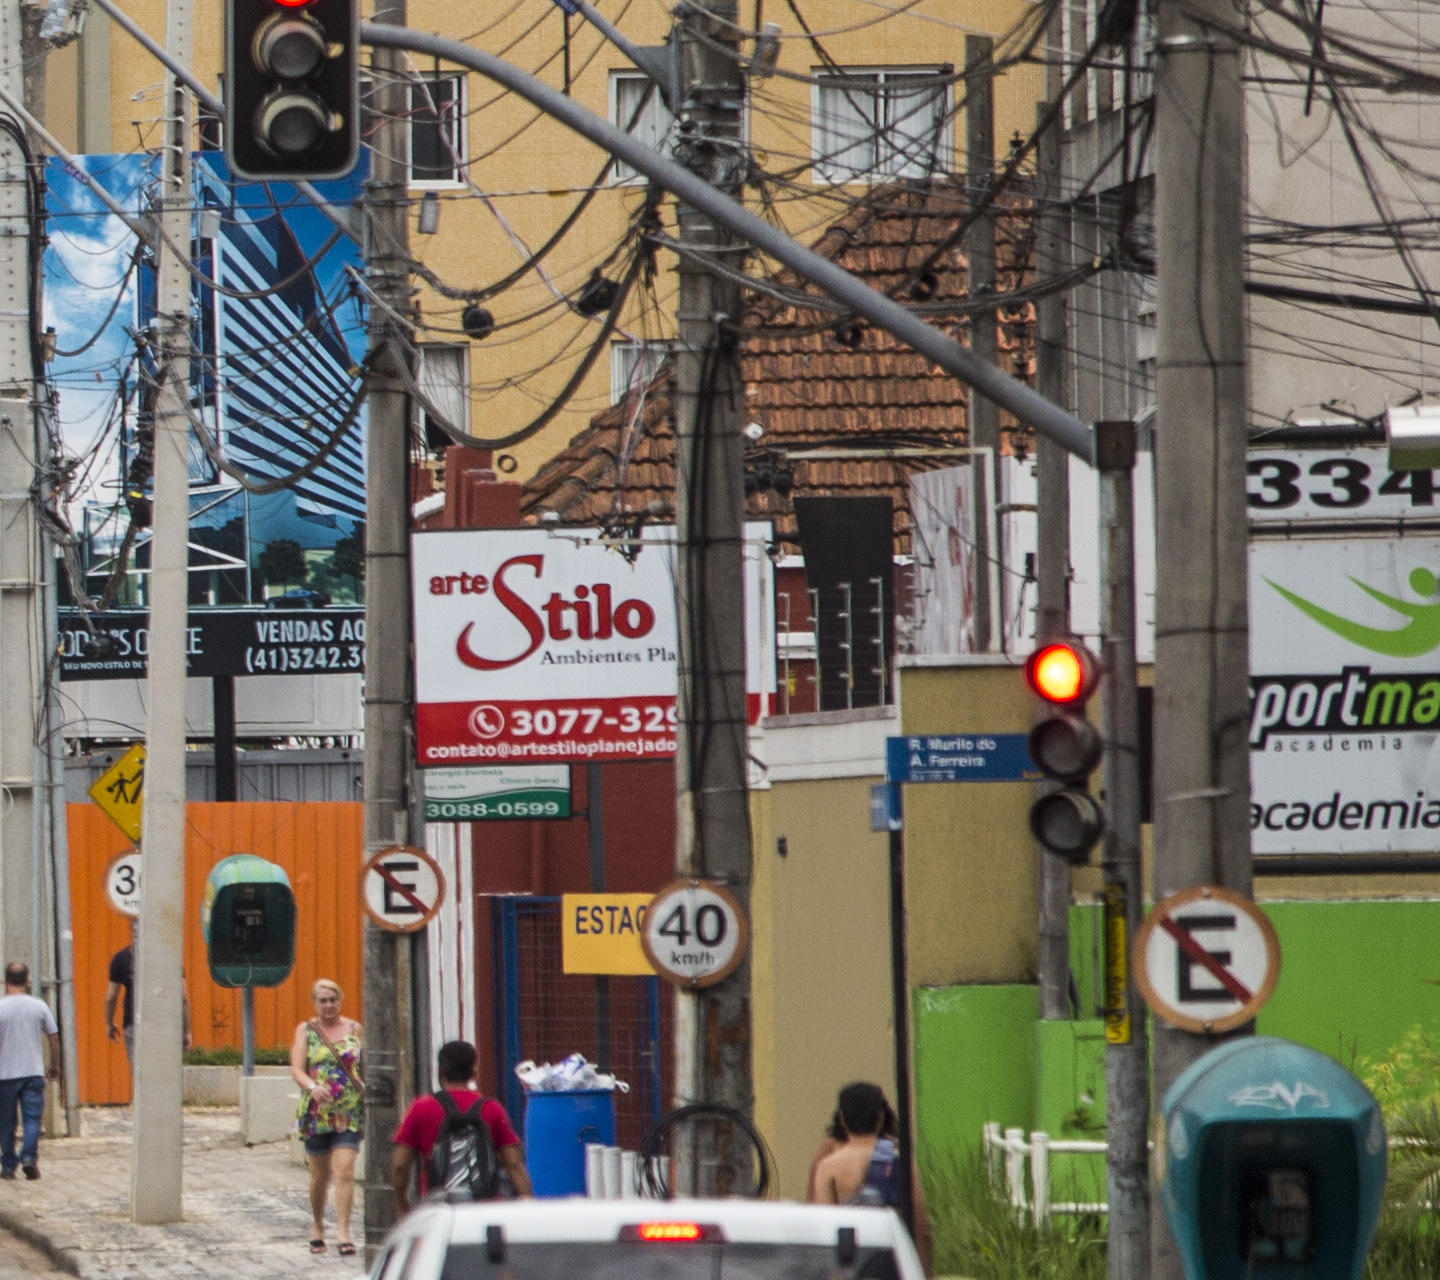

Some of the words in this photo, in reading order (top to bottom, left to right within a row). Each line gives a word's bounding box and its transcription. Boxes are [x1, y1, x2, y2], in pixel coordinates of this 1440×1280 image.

[429, 570, 488, 596] arte
[456, 553, 656, 671] Stilo
[256, 619, 335, 643] VENDAS
[64, 662, 80, 670] SEU
[105, 661, 130, 669] ESTILO
[540, 650, 643, 665] Ambientes
[646, 647, 677, 663] Pla
[1248, 672, 1440, 750] portma
[426, 736, 677, 759] contato@artestiloplanejado
[908, 738, 925, 751] R.
[927, 738, 974, 751] Murilo
[976, 738, 997, 751] do
[1274, 732, 1404, 752] academia
[910, 754, 927, 768] A.
[930, 754, 986, 768] Ferreira
[426, 801, 560, 817] 3088-0599
[1250, 791, 1440, 831] academia
[116, 864, 141, 895] 3
[384, 861, 420, 915] E
[658, 904, 728, 947] 40
[671, 952, 715, 965] km/h
[1177, 915, 1237, 1003] E
